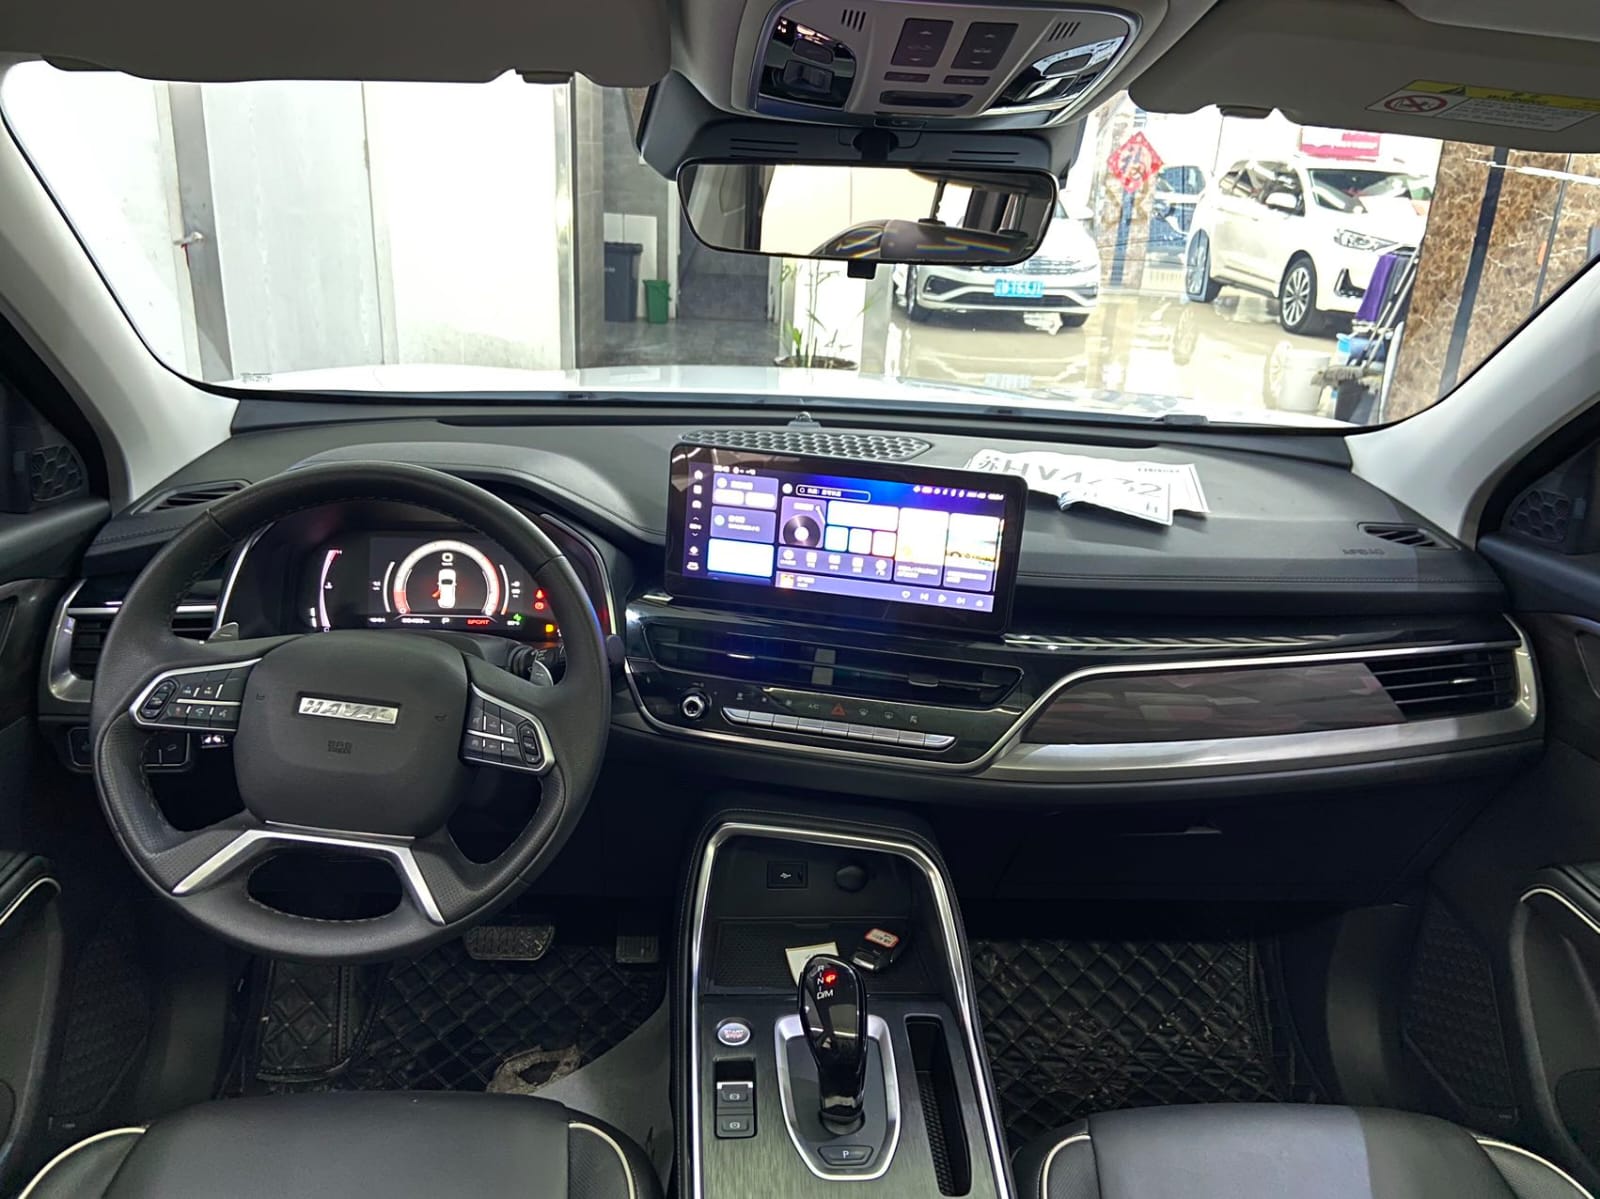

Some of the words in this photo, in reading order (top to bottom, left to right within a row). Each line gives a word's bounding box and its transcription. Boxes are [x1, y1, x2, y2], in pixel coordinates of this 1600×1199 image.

[303, 700, 395, 721] HAVAL
[817, 976, 824, 985] N
[842, 1150, 850, 1159] P
